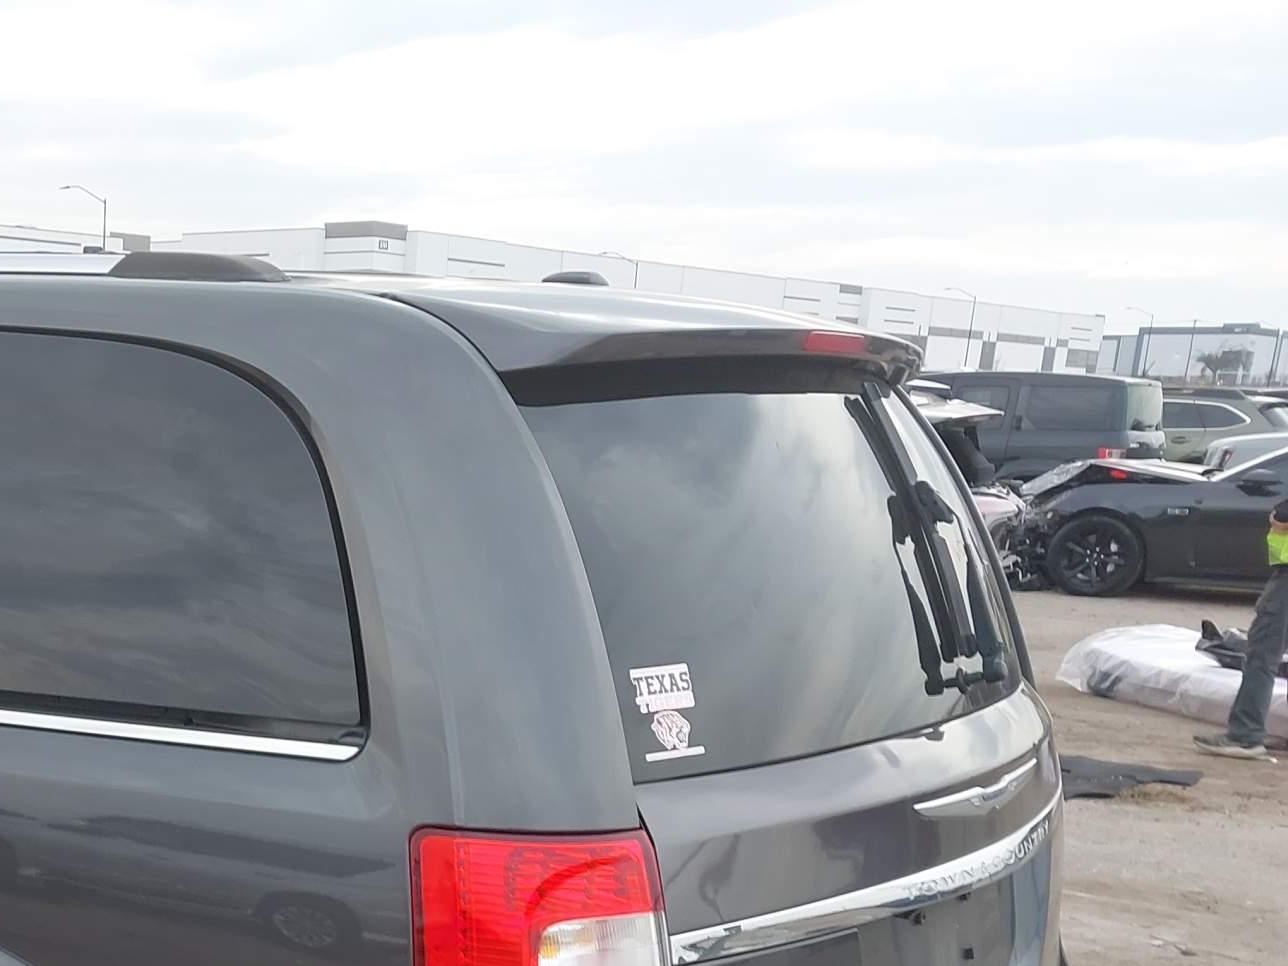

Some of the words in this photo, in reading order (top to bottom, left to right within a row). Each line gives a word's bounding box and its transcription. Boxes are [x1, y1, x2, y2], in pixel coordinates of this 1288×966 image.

[633, 672, 690, 696] TEXAS
[904, 866, 975, 900] TOWN
[992, 818, 1049, 867] COUNTRY
